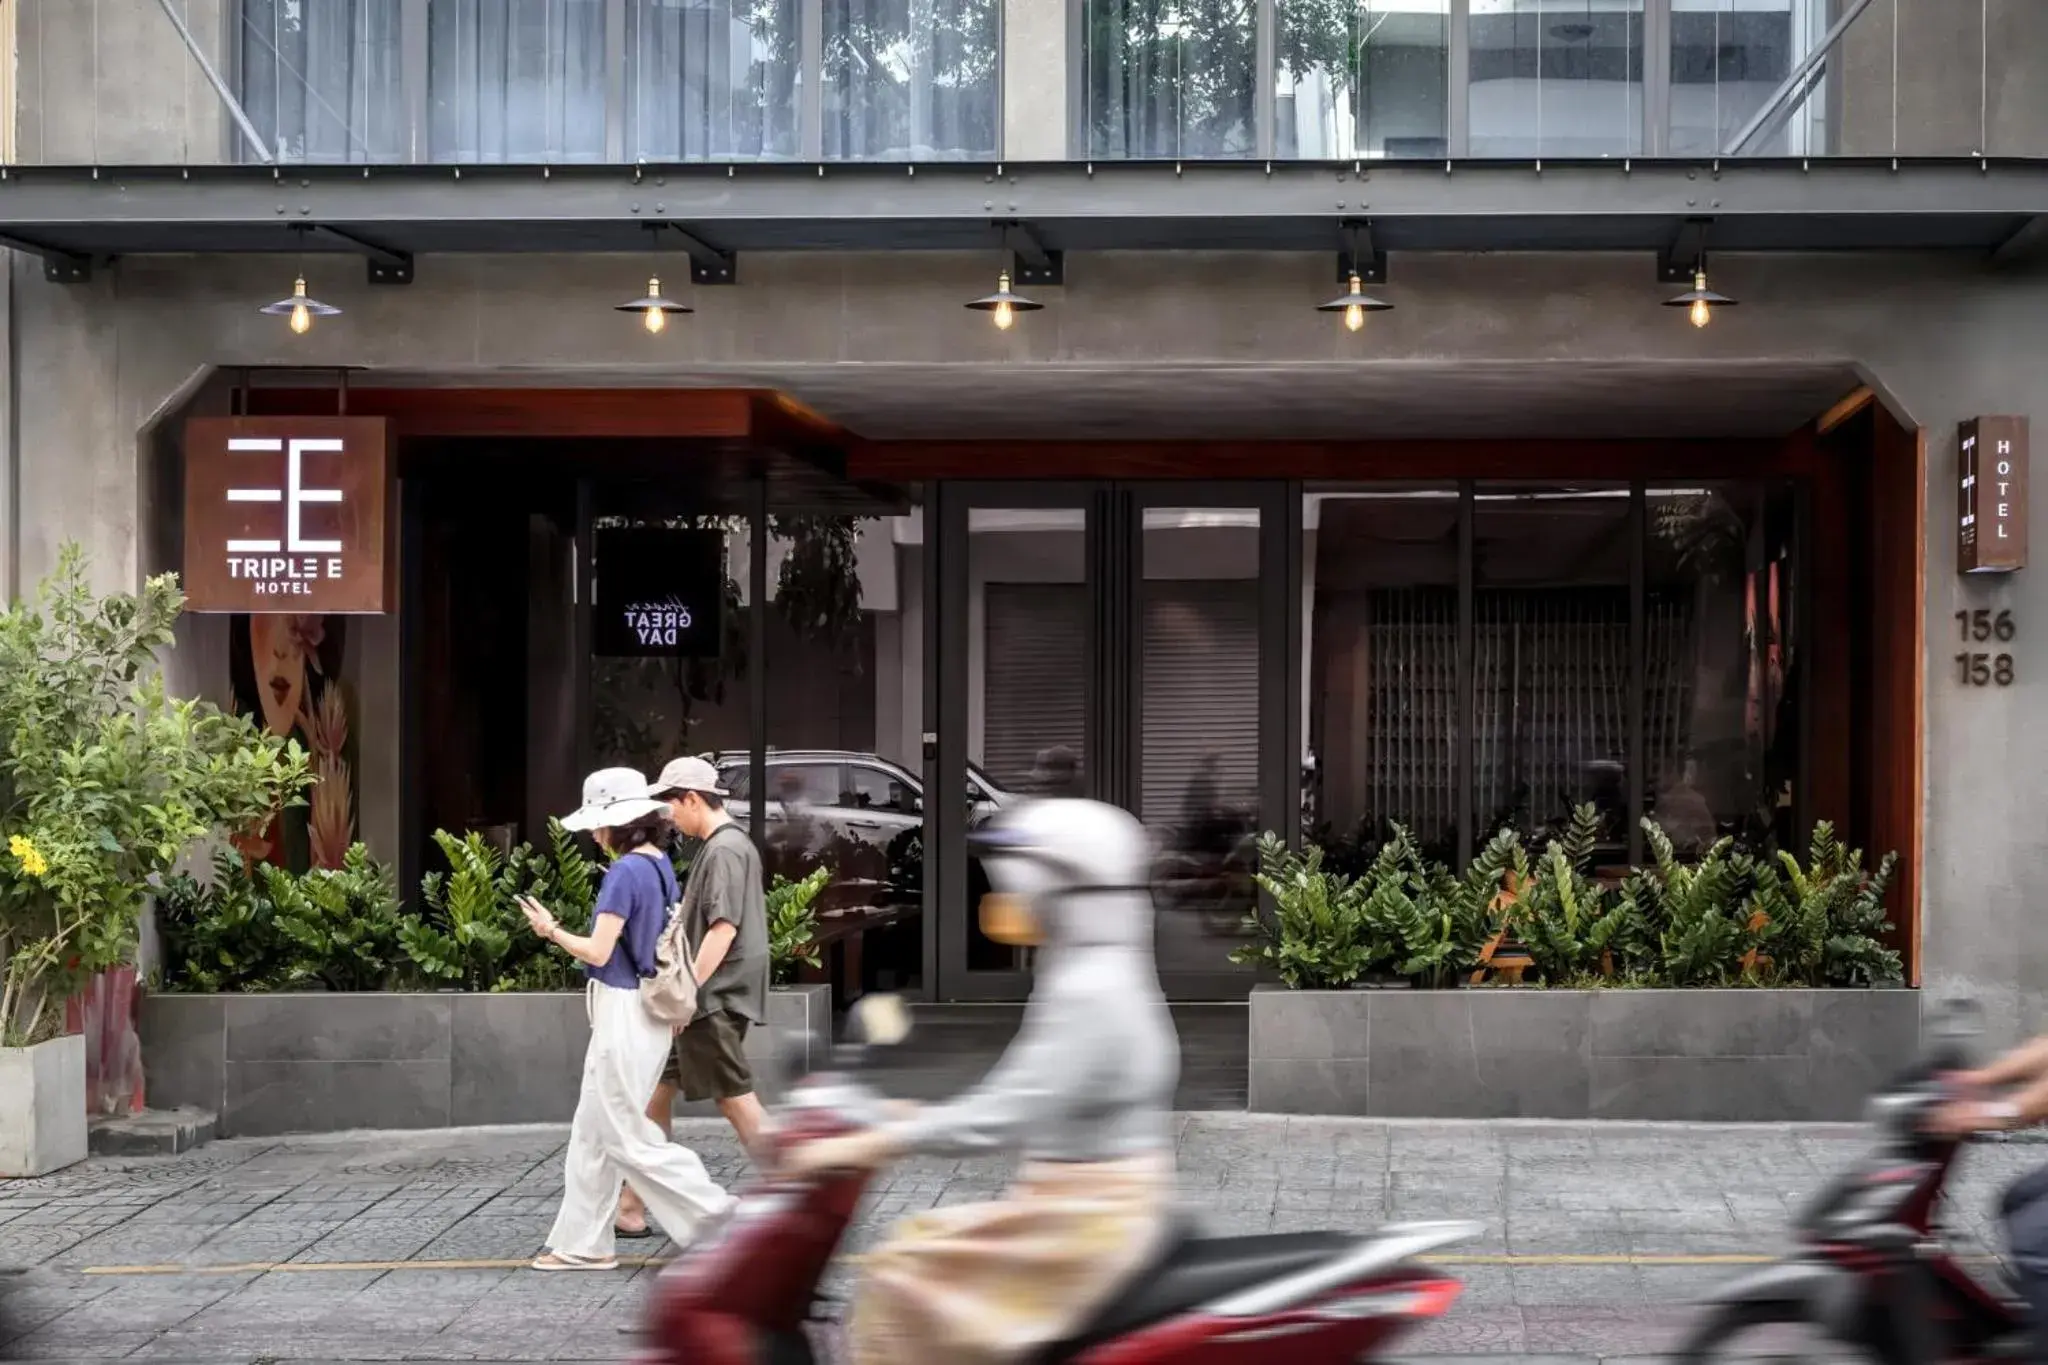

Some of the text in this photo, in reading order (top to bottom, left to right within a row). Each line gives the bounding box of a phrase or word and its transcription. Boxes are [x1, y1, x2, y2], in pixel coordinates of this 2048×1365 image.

[1997, 440, 2010, 538] HOTEL
[227, 558, 342, 578] TRIPLE E
[255, 582, 312, 594] HOTEL
[1955, 609, 2016, 642] 156
[1955, 652, 2015, 687] 158
